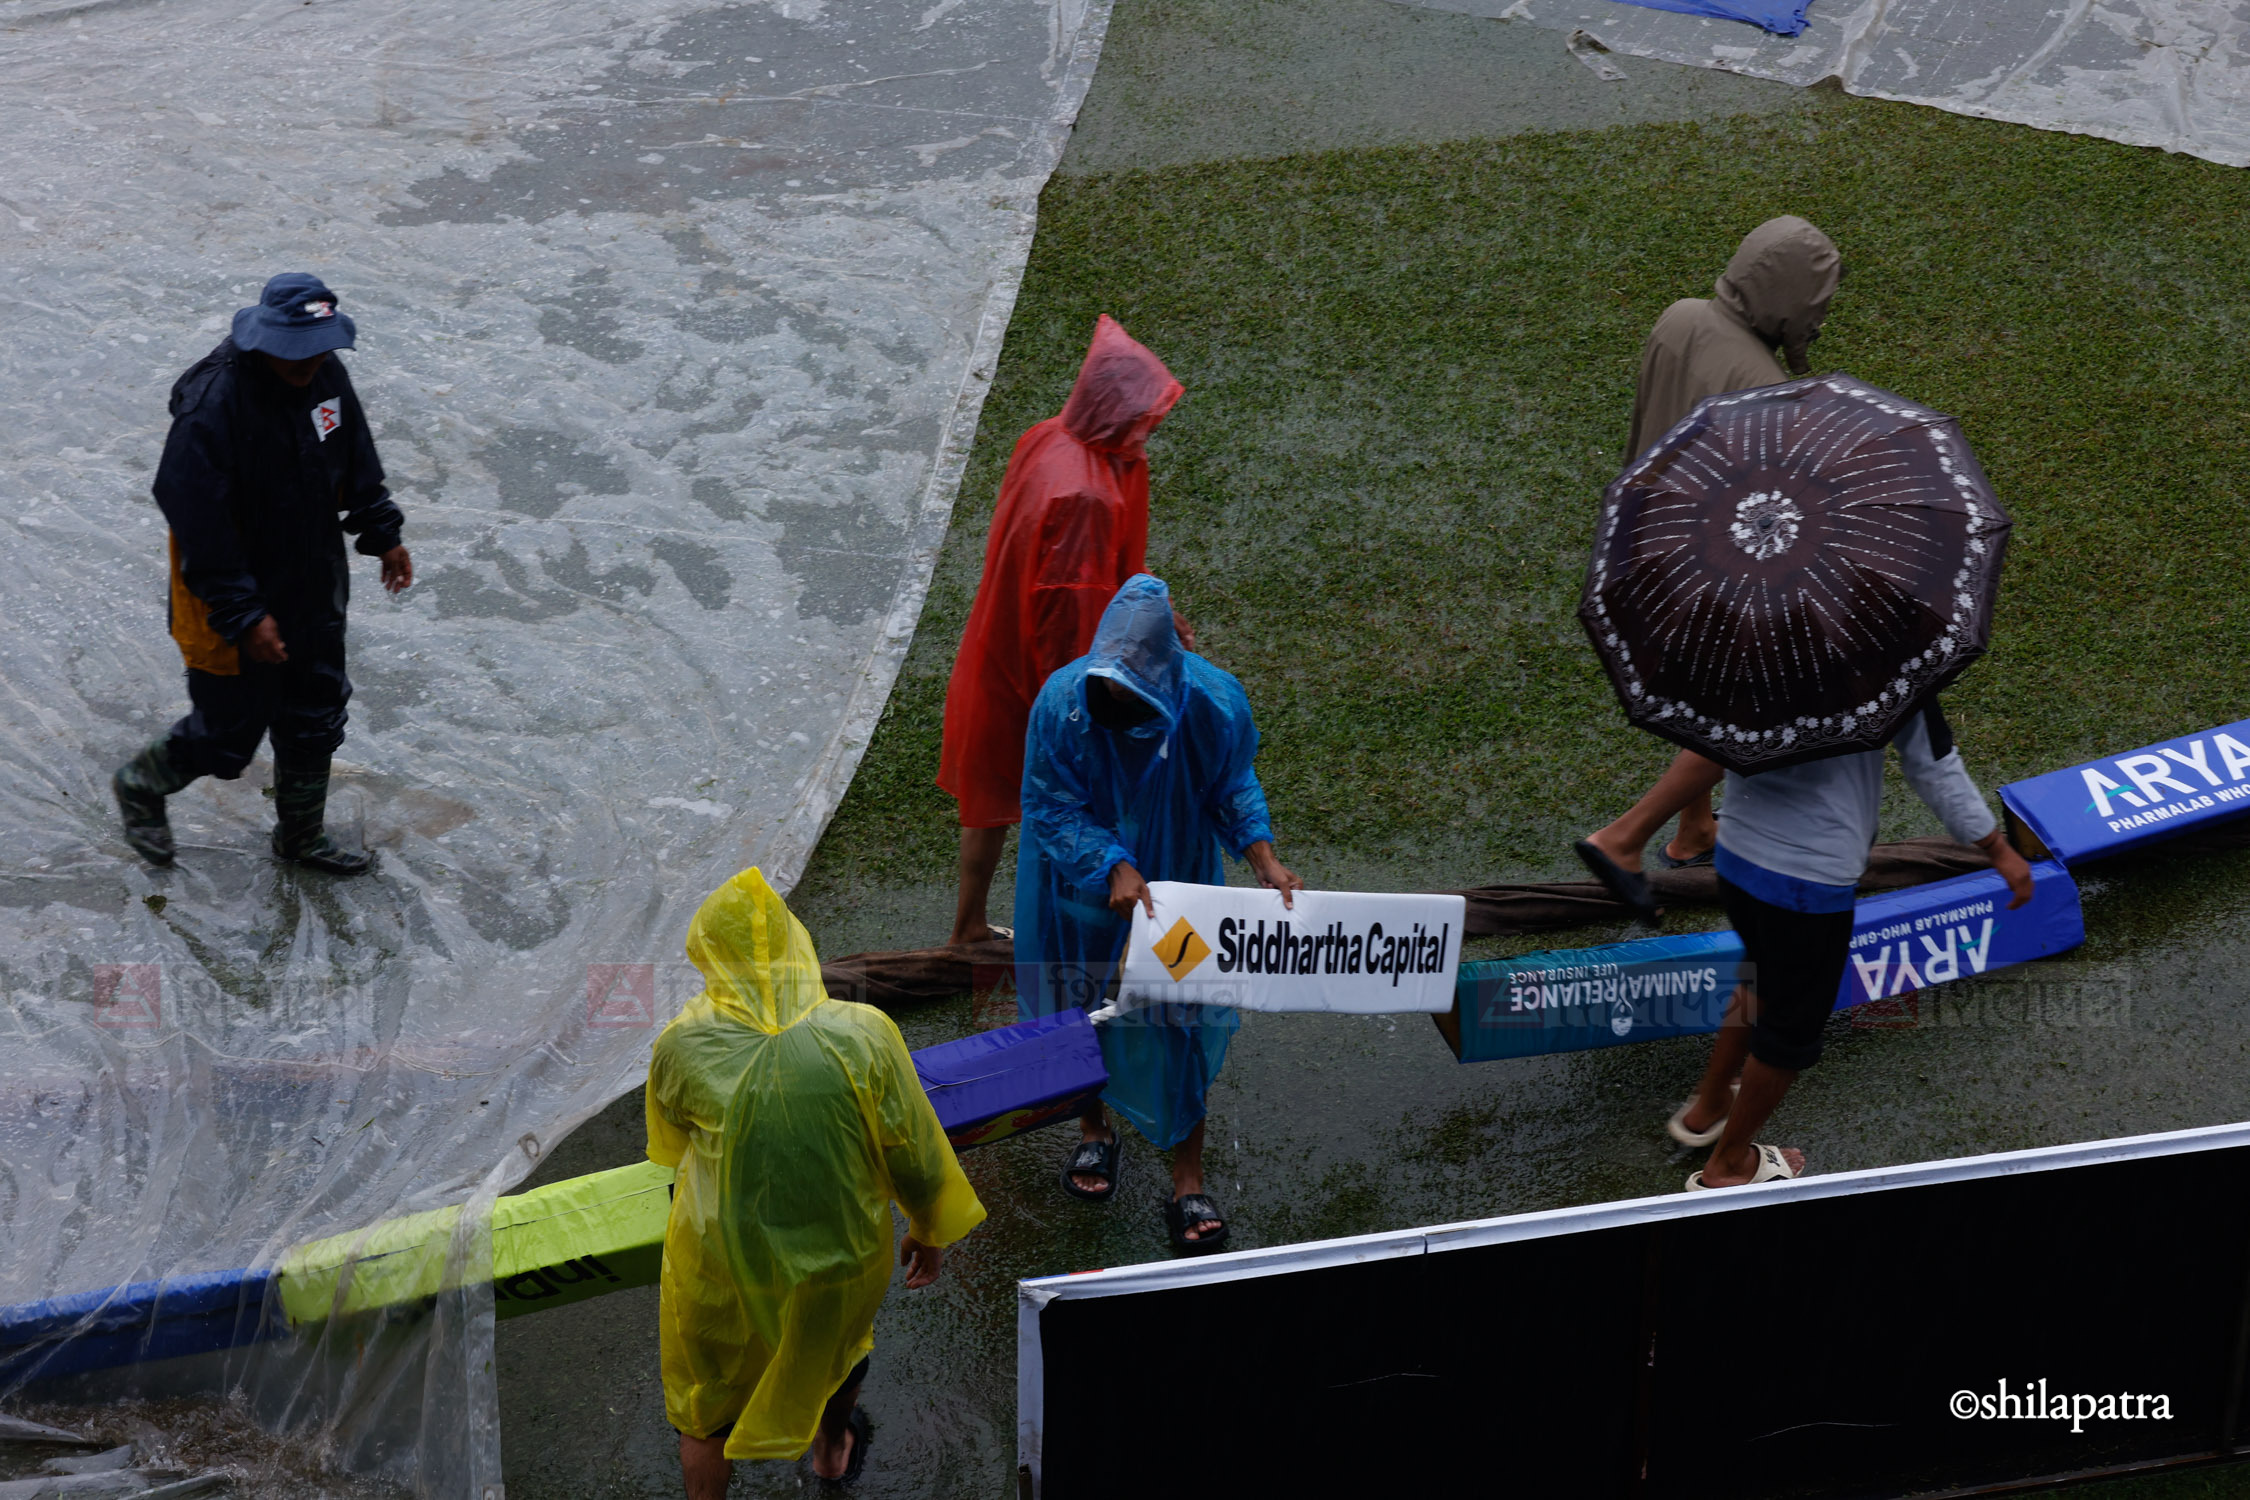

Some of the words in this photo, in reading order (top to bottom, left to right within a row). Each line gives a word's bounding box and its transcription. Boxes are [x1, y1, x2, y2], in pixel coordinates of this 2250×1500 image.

[2080, 732, 2250, 817] ARYA
[2107, 794, 2216, 833] PHARMALAB
[1914, 899, 1995, 932] PHARMALAB
[1217, 917, 1363, 975] Siddhartha
[1365, 921, 1449, 988] Capital
[1850, 917, 1995, 1002] ARYA
[1508, 965, 1589, 985] INSURANCE
[1592, 962, 1619, 978] LIFE
[1627, 967, 1717, 1000] SANIMA
[1510, 978, 1619, 1012] RELIANCE
